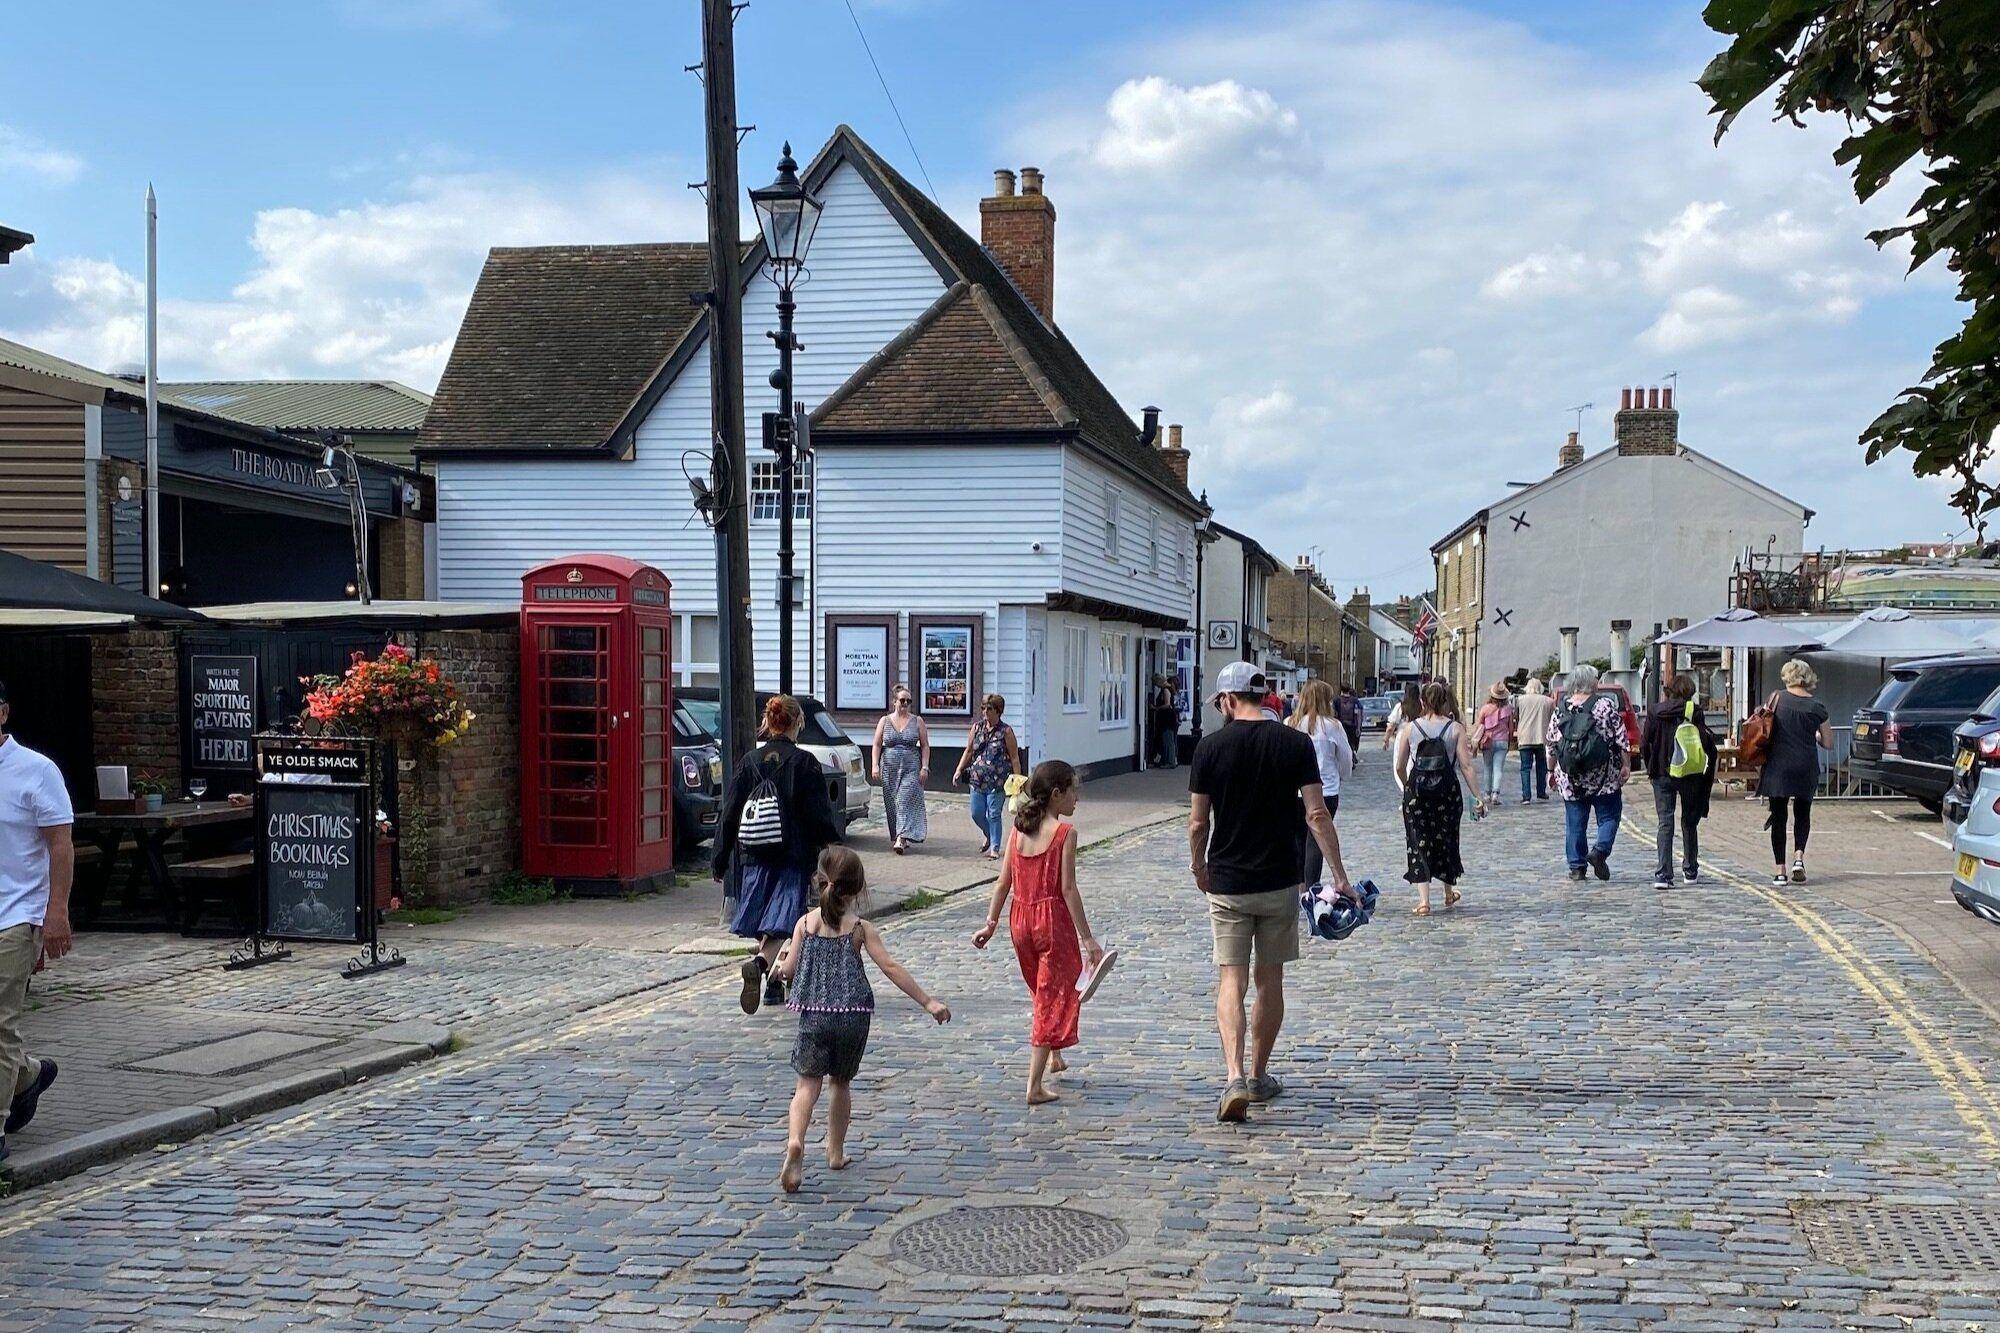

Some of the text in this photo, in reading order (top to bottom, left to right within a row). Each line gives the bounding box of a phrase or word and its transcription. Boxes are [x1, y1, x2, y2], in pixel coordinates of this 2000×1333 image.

[232, 448, 262, 476] THE
[539, 587, 614, 600] TELEPHONE
[208, 678, 240, 692] MAJOR
[193, 692, 251, 710] SPORTING
[204, 710, 252, 729] EVENTS
[268, 755, 359, 769] YE OLDE SMACK
[267, 812, 353, 839] CHRISTMAS
[270, 841, 350, 870] BOOKINGS
[288, 869, 329, 881] NOW BEING
[302, 880, 324, 890] TAKEN
